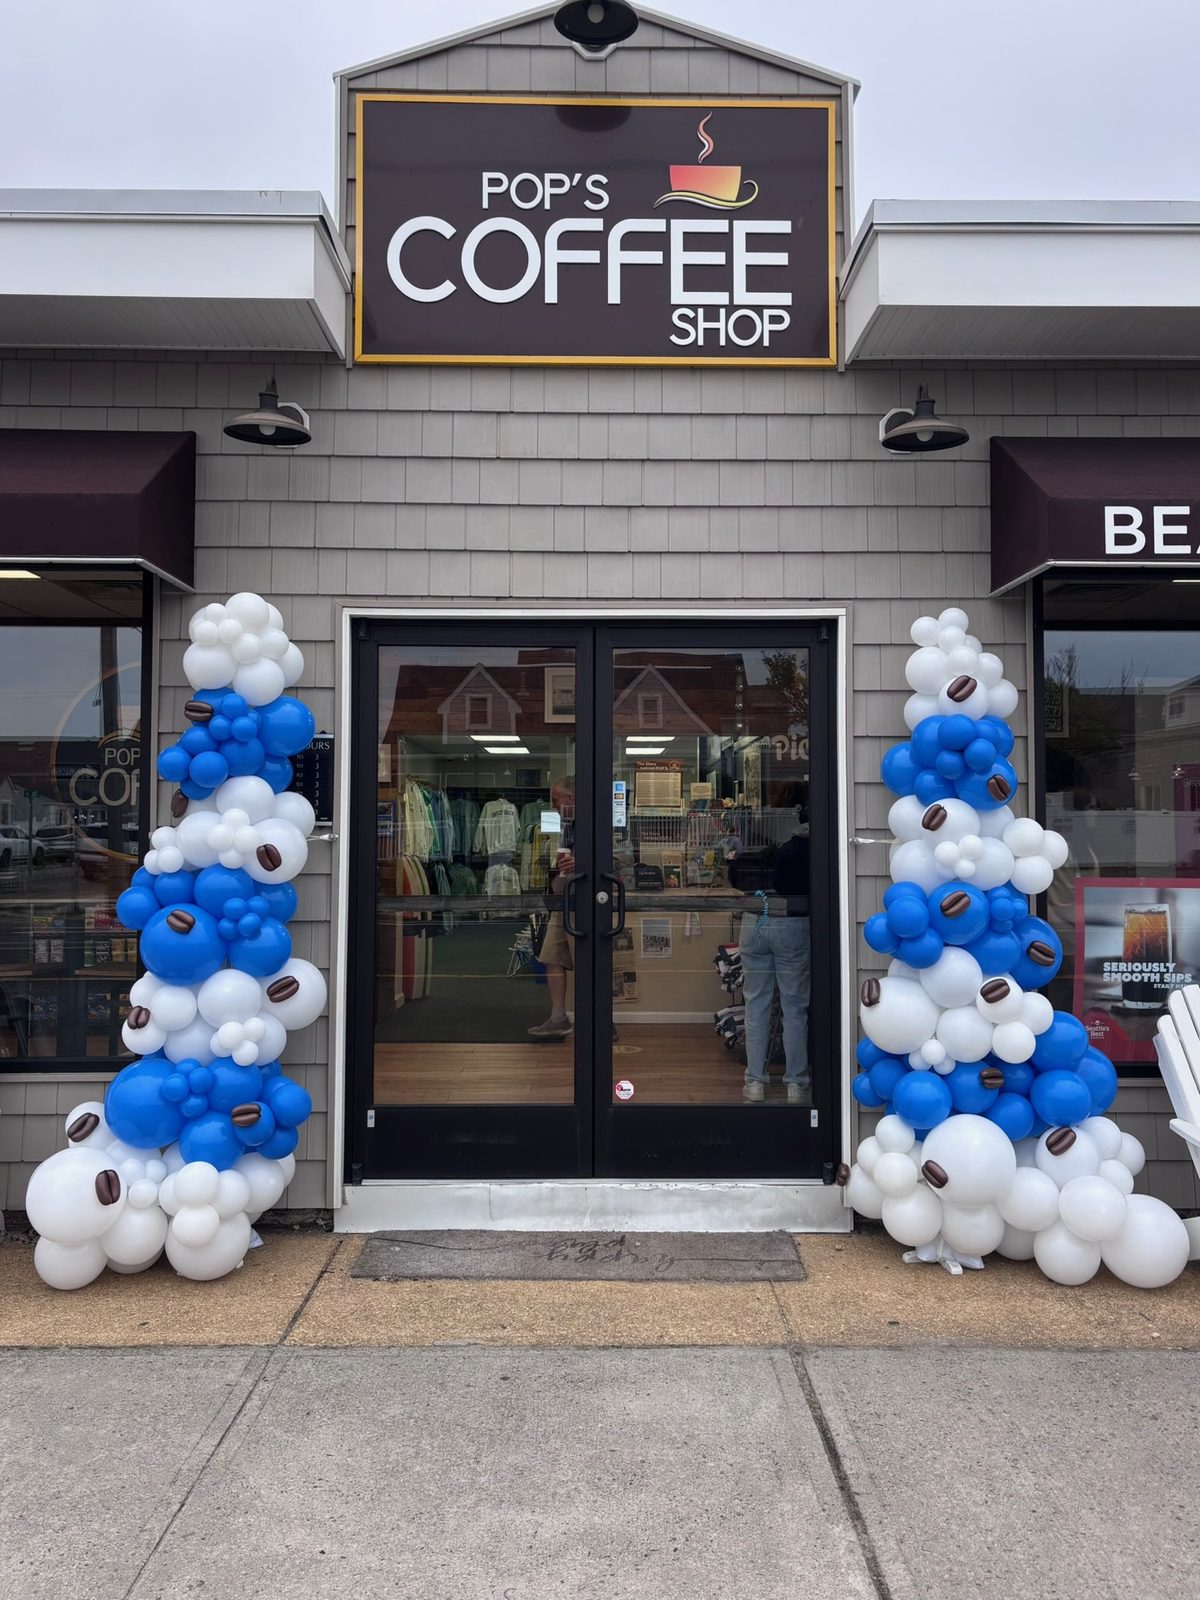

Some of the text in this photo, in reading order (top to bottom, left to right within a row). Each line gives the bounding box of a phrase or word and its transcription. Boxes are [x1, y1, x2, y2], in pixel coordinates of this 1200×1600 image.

[481, 171, 610, 211] POP'S
[386, 215, 793, 306] COFFEE
[669, 307, 792, 347] SHOP
[1103, 504, 1200, 555] BE
[105, 748, 140, 766] POP
[1103, 962, 1176, 972] SERIOUSLY
[1103, 973, 1193, 983] SMOOTH SIPS
